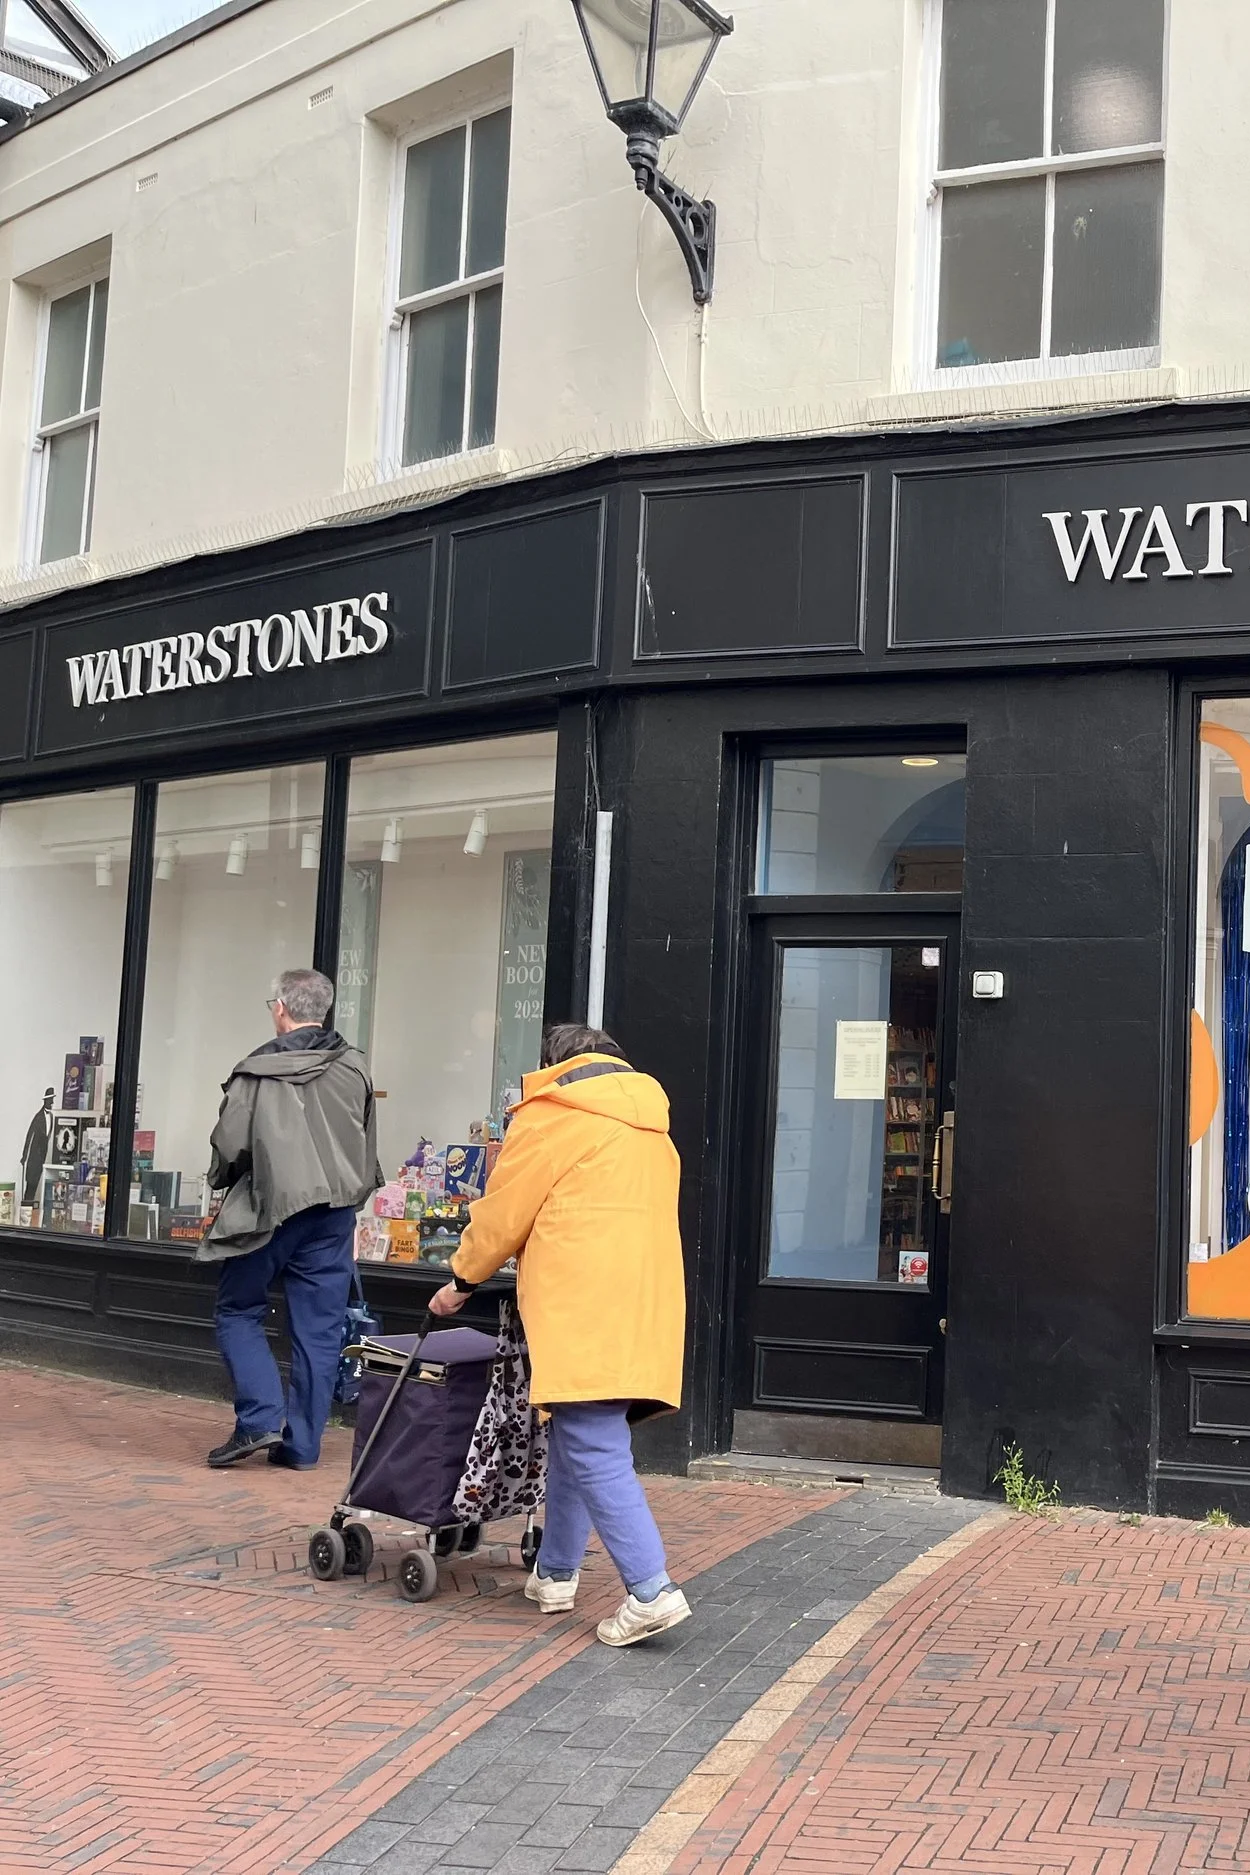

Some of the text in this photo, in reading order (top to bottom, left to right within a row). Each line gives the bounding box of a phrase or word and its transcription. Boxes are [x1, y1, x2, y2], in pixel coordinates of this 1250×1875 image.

[66, 592, 389, 707] WATERSTONES
[339, 950, 363, 967] EW
[395, 1245, 415, 1253] BINGO
[397, 1239, 413, 1247] FART
